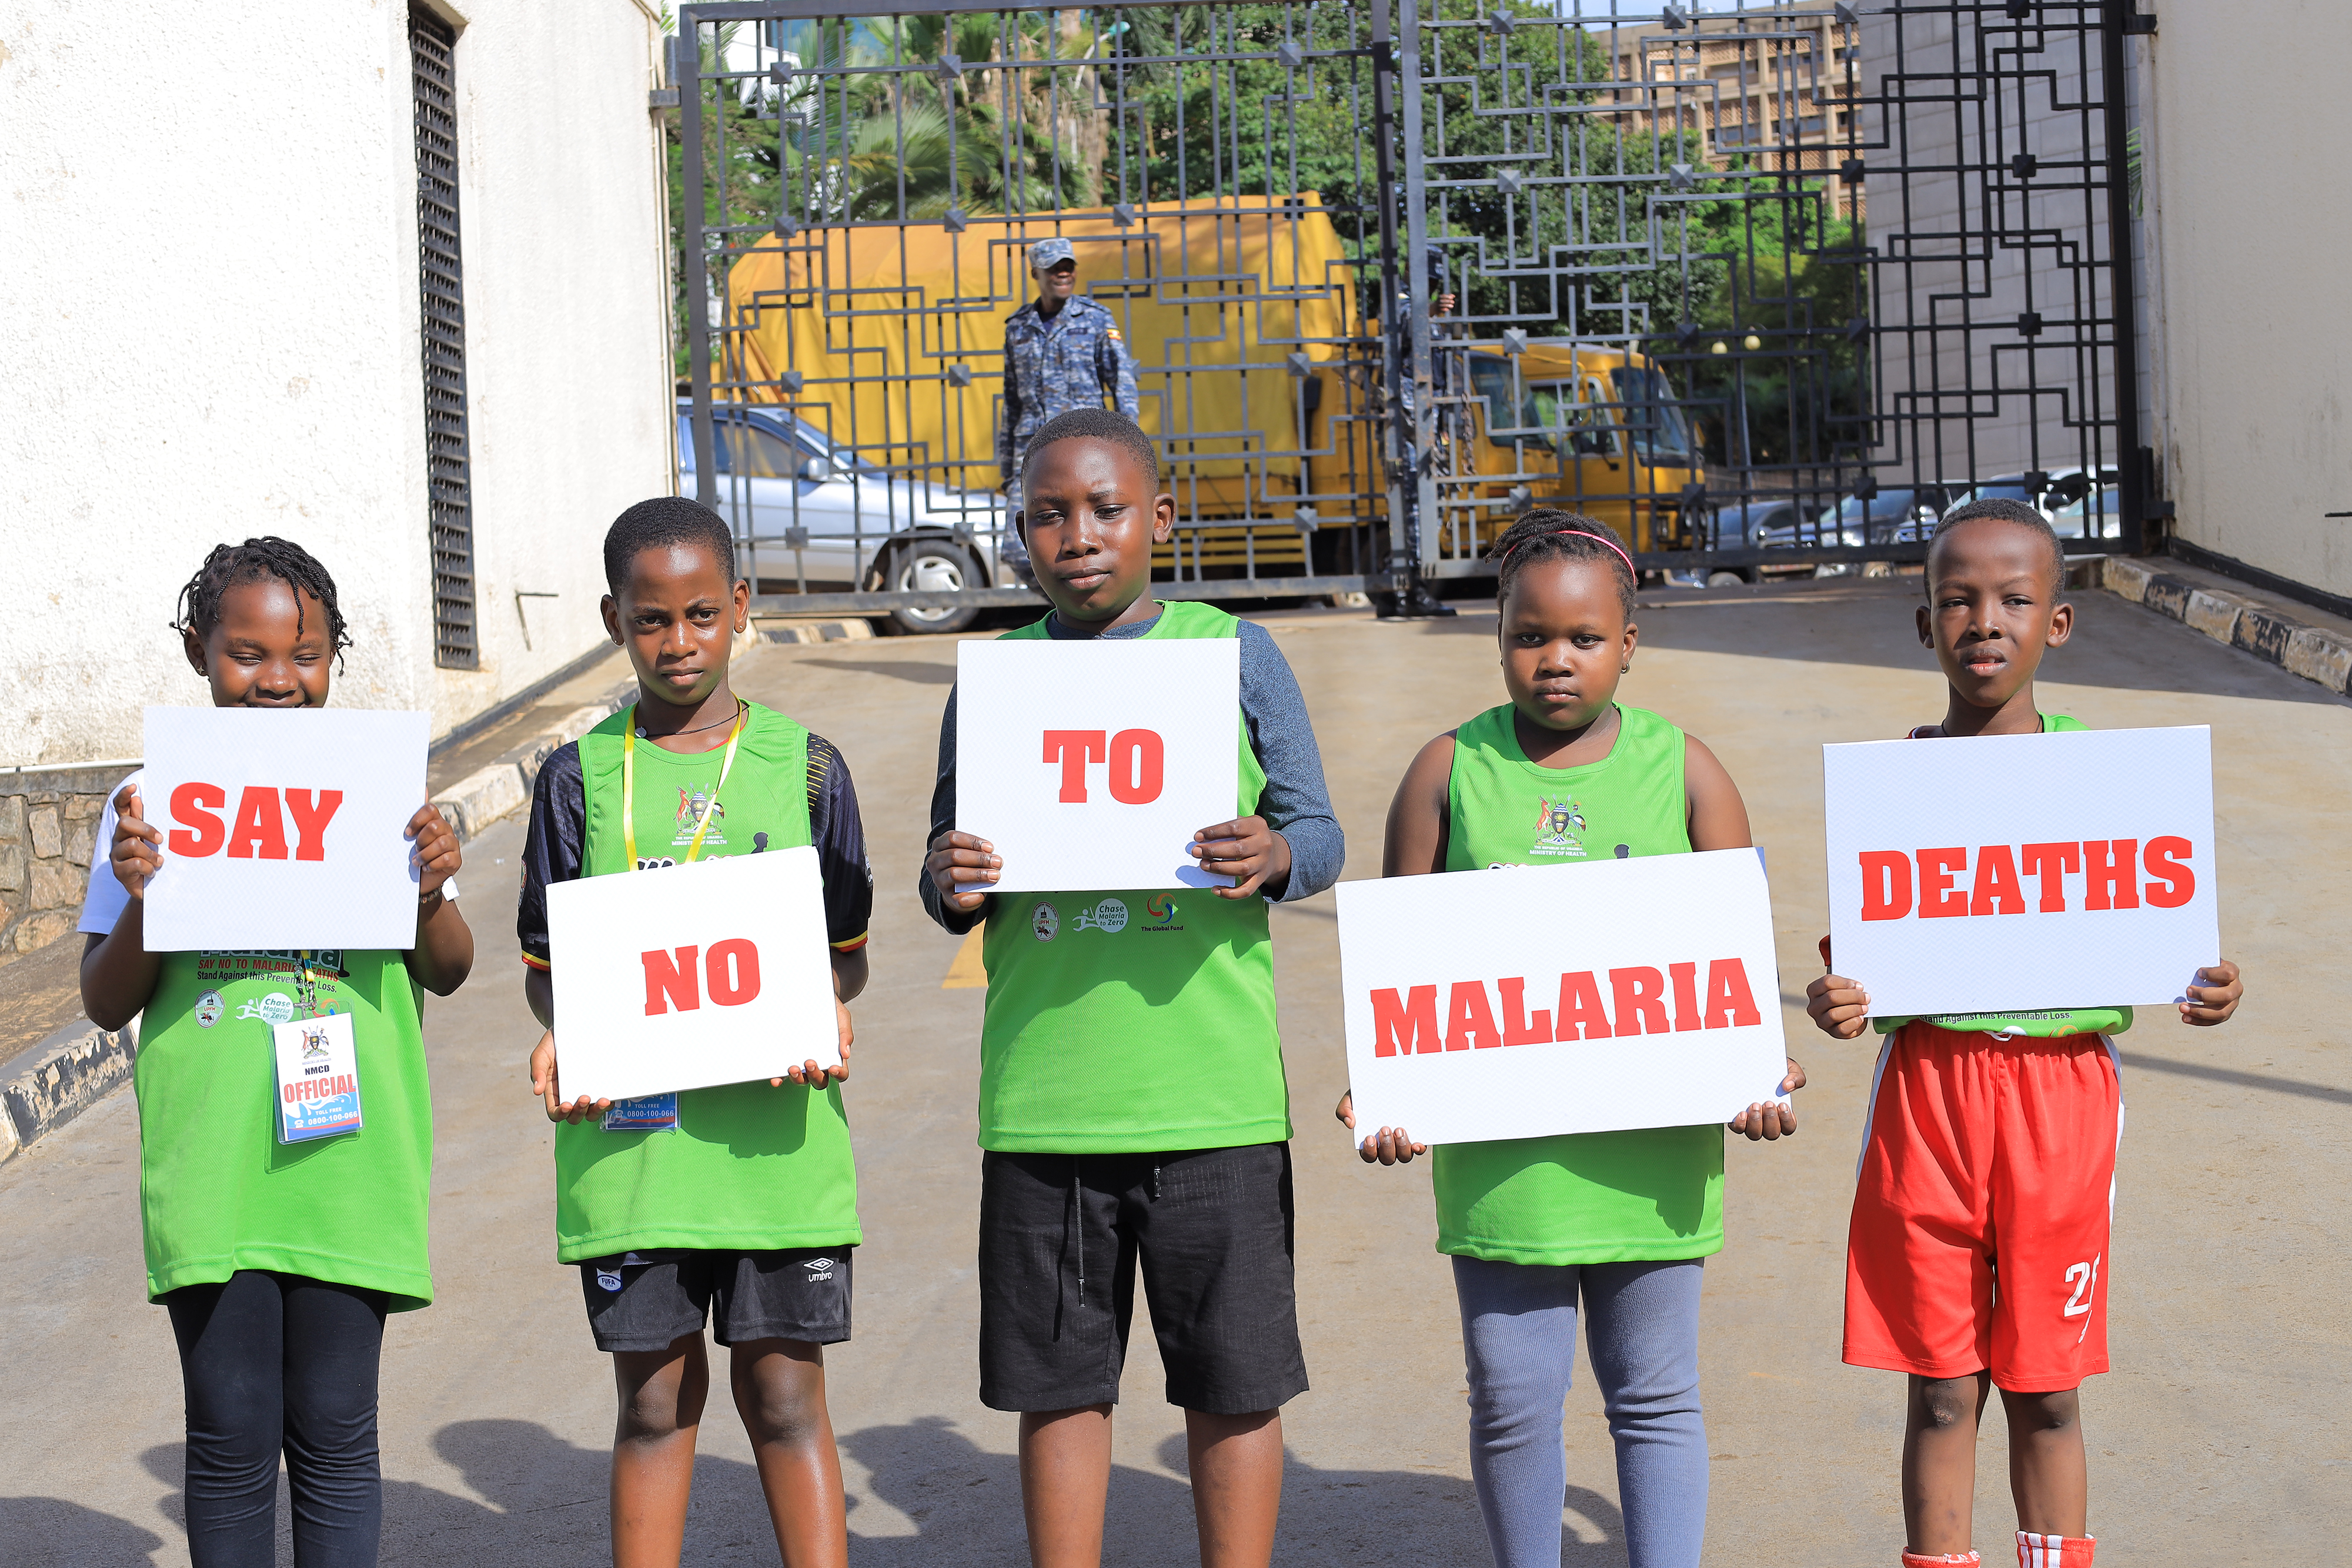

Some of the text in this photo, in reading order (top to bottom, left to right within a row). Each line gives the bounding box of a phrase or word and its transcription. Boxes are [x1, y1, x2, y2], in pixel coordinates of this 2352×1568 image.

[1043, 728, 1164, 804] TO
[168, 782, 343, 861] SAY
[1859, 835, 2196, 921] DEATHS
[1099, 905, 1124, 913] Chase
[198, 959, 215, 969] SAY
[218, 959, 231, 969] NO
[236, 959, 248, 969] TO
[197, 971, 218, 980] Stand
[218, 971, 248, 982] Against
[249, 971, 265, 981] this
[318, 980, 337, 992] Loss.
[642, 938, 760, 1016] NO
[265, 998, 290, 1007] Chase
[1370, 958, 1761, 1058] MALARIA
[262, 1005, 290, 1014] Malaria
[270, 1012, 288, 1020] Zero
[1919, 1014, 1944, 1024] Stand
[1945, 1013, 1977, 1024] Against
[1997, 1012, 2048, 1020] Preventable
[2050, 1011, 2073, 1019] Loss.
[305, 1065, 330, 1075] NMCD
[283, 1074, 356, 1104] OFFICIAL
[308, 1111, 358, 1125] 0800-100-066
[601, 1278, 616, 1286] FUFA
[808, 1271, 833, 1283] umbro
